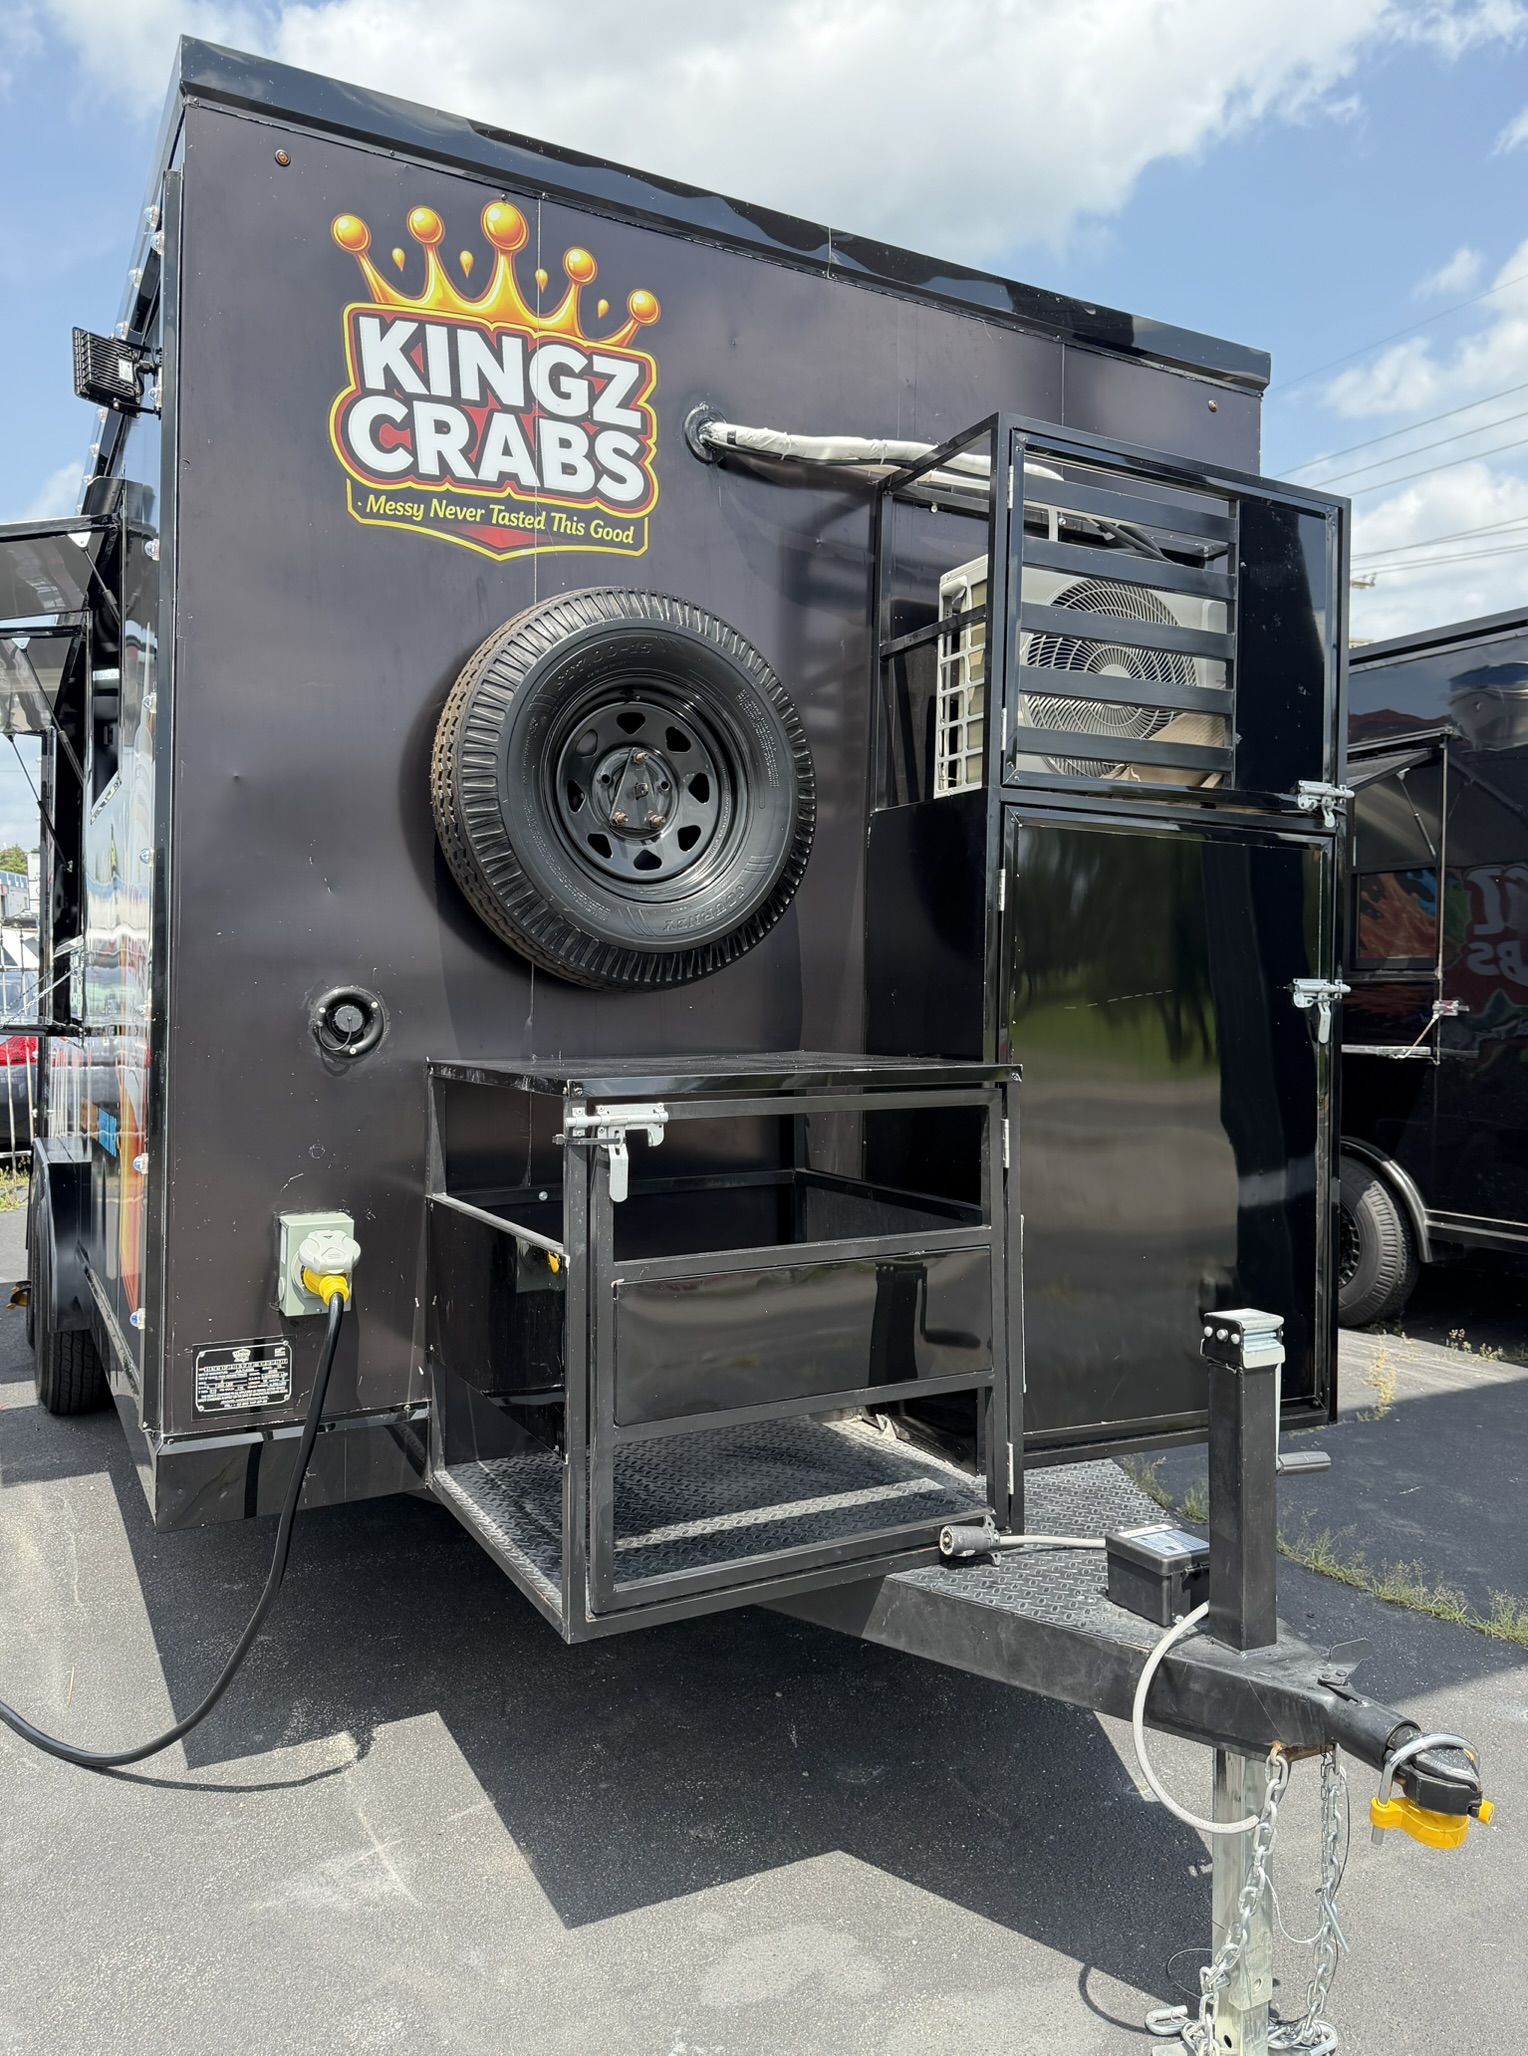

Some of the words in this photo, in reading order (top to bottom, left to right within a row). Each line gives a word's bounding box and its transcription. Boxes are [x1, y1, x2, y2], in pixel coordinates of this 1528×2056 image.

[358, 316, 642, 429] KINGZ
[348, 396, 645, 501] CRABS
[366, 494, 424, 521] Messy
[430, 499, 486, 522] Never
[489, 504, 546, 530] Tasted
[550, 512, 587, 536] This
[589, 519, 635, 544] Good
[661, 883, 746, 932] JOURNEY
